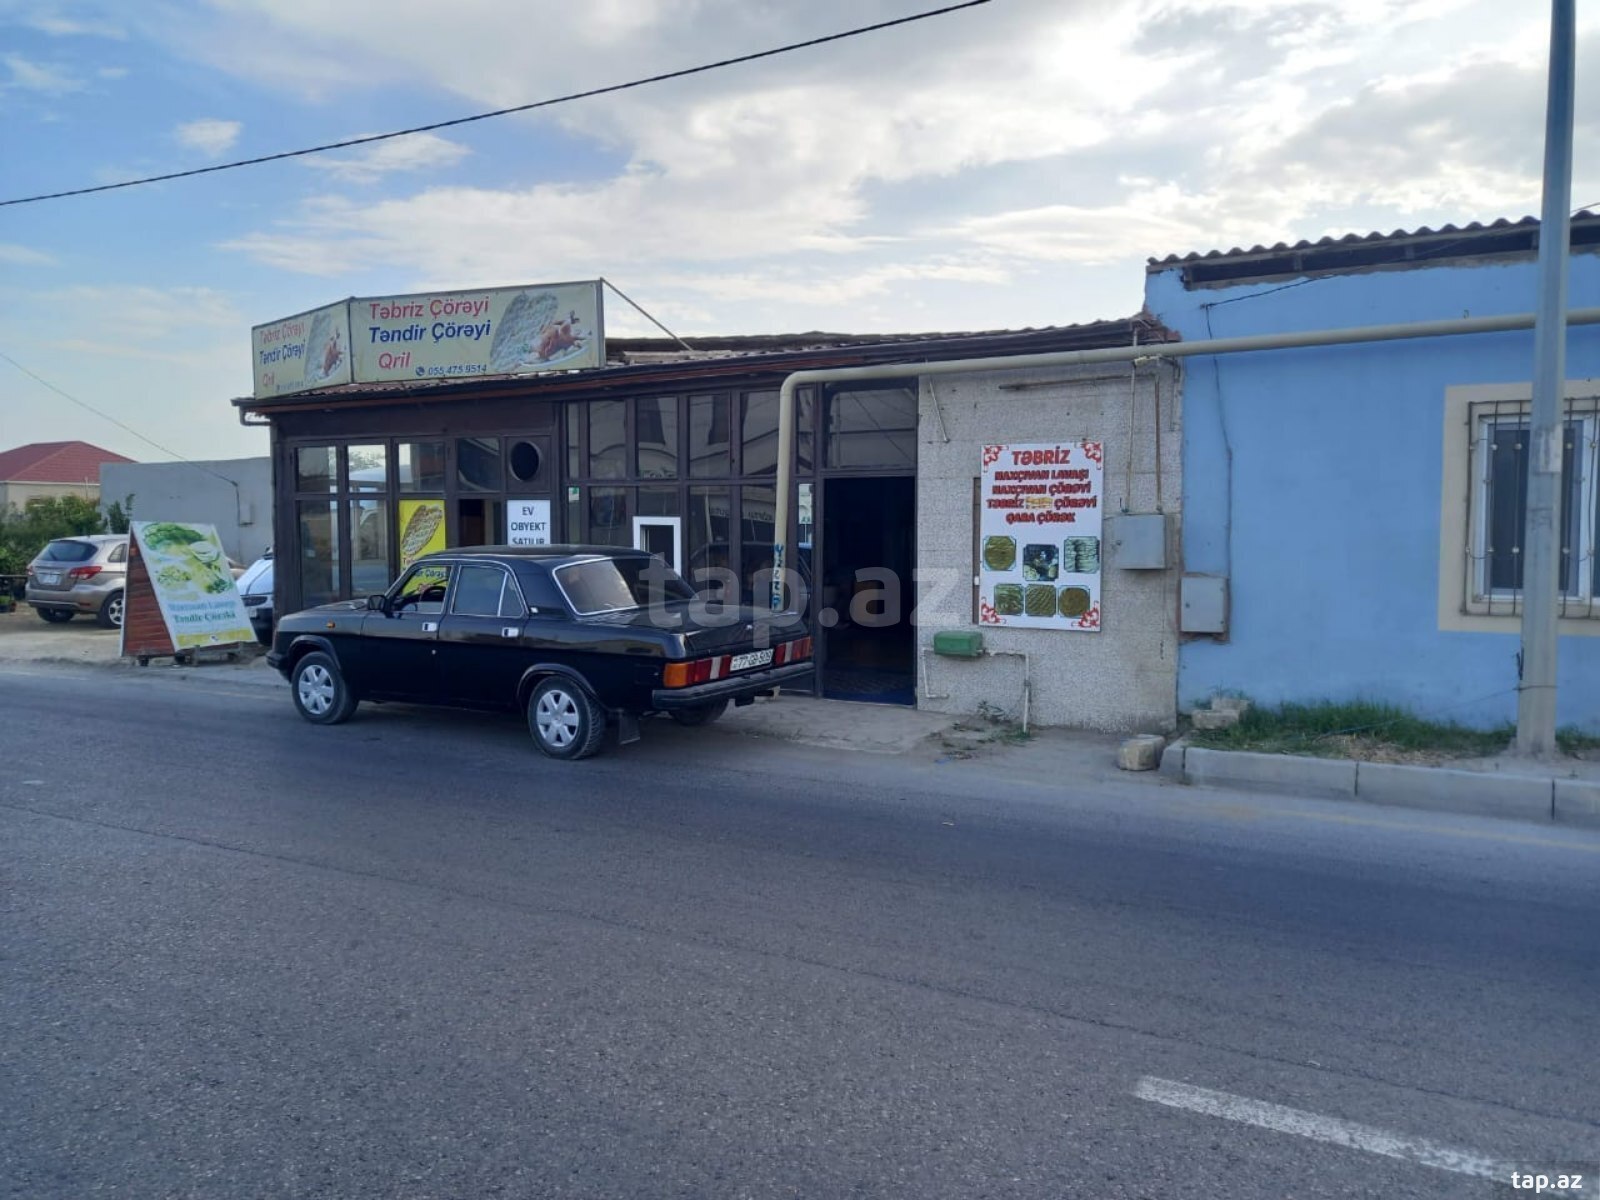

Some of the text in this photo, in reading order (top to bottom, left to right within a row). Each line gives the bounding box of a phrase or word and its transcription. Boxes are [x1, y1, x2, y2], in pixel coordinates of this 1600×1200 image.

[369, 296, 490, 320] Təbriz Çörəyi
[369, 319, 491, 344] Təndir Çörəyi
[378, 352, 411, 370] Qril
[1012, 446, 1071, 466] TƏBRİZ
[522, 506, 535, 516] EV
[511, 521, 547, 531] OBYEKT
